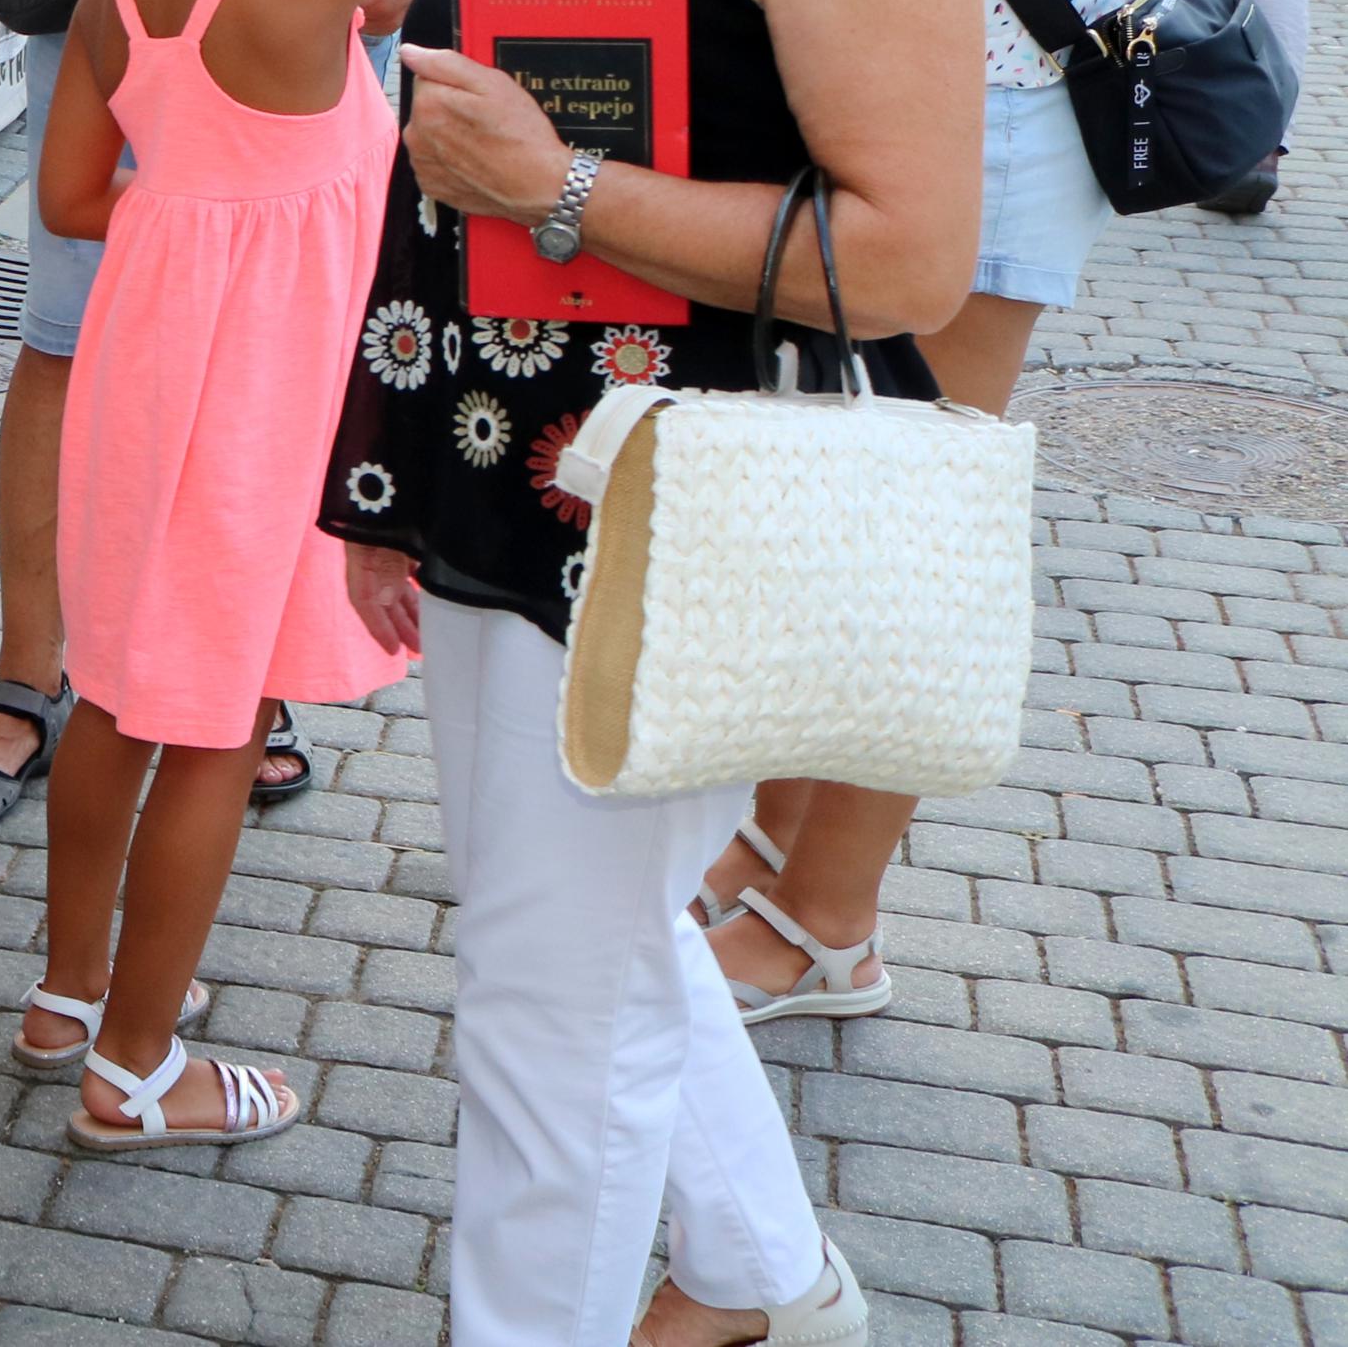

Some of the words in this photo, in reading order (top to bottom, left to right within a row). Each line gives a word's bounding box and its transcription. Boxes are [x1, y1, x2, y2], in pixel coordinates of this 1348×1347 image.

[515, 71, 544, 90] Un
[550, 73, 631, 92] extraño
[543, 96, 561, 113] el
[567, 97, 634, 120] espejo
[1134, 138, 1149, 169] FREE
